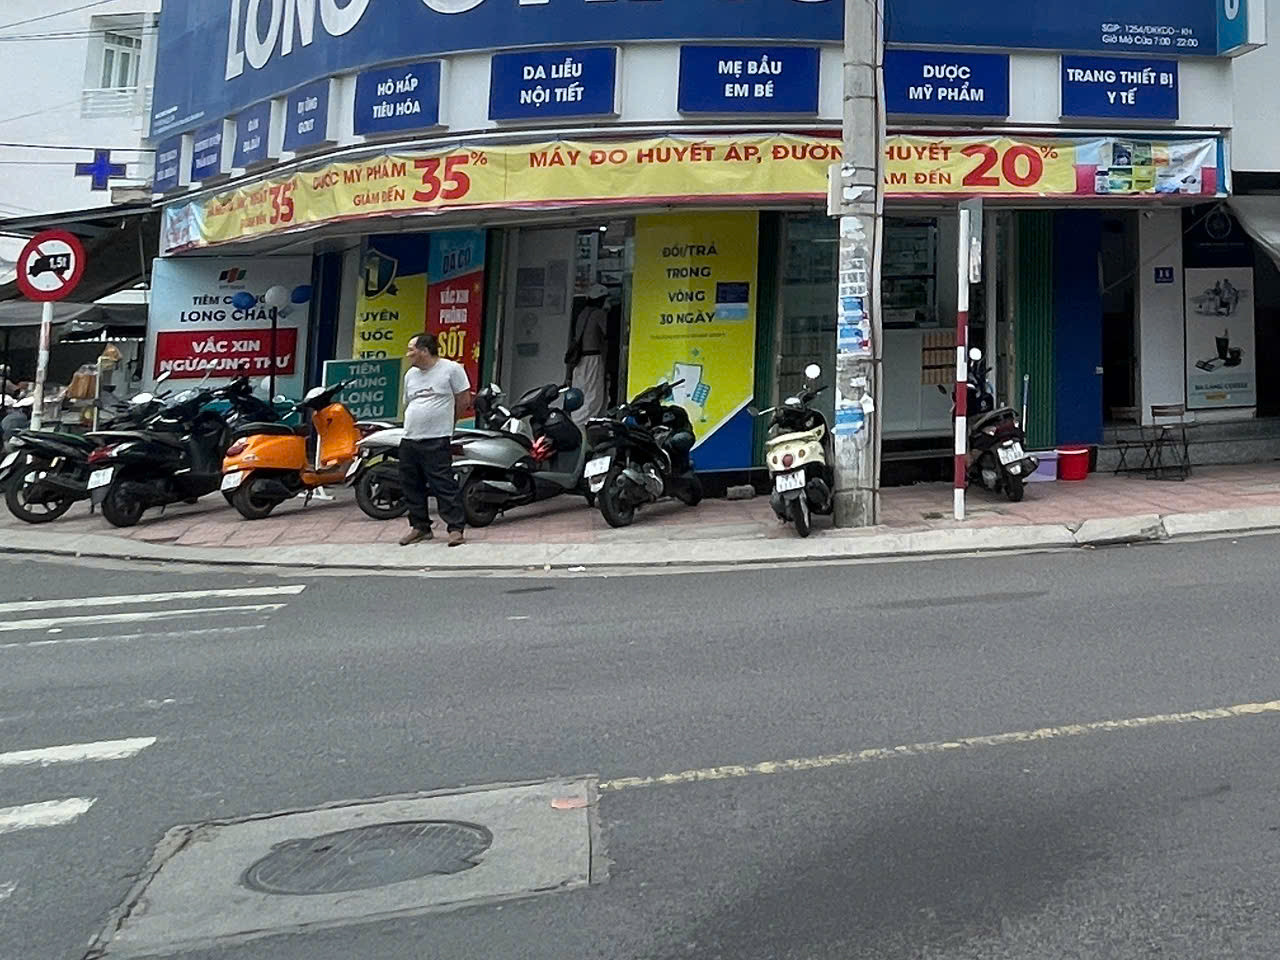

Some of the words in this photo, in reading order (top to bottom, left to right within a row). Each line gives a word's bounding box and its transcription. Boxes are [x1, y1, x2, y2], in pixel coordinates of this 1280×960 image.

[1102, 34, 1118, 44] Giờ
[1119, 36, 1133, 45] Mở
[1134, 36, 1153, 45] Cửa
[524, 65, 547, 81] DA
[551, 57, 583, 79] LIỄU
[718, 61, 743, 81] MẸ
[747, 54, 783, 77] BẦU
[923, 63, 971, 83] DƯỢC
[377, 81, 394, 97] HÔ
[395, 76, 419, 94] HẤP
[1067, 67, 1117, 84] TRANG
[1120, 67, 1157, 85] THIẾT
[1160, 72, 1174, 89] BỊ
[520, 86, 549, 107] NỘI
[554, 80, 585, 103] TIẾT
[725, 84, 748, 98] EM
[754, 80, 774, 98] BÉ
[909, 83, 934, 101] MỸ
[938, 79, 984, 102] PHẨM
[1107, 91, 1117, 105] Y
[1120, 87, 1138, 105] TẾ
[373, 99, 395, 118] TIÊU
[398, 99, 421, 116] HÓA
[529, 146, 580, 168] MÁY
[588, 148, 628, 165] ĐO
[636, 140, 716, 164] HUYẾT
[723, 143, 762, 163] ÁP,
[771, 143, 843, 161] ĐƯỜN
[343, 164, 362, 184] MỸ
[366, 159, 406, 181] PHẨM
[961, 143, 1059, 188] 20%
[413, 151, 488, 203] 35%
[914, 168, 951, 187] ĐẾN
[666, 267, 712, 279] TRONG
[668, 289, 705, 303] VÒNG
[181, 310, 226, 323] LONG
[360, 309, 399, 321] UYÊN
[660, 314, 674, 325] 30
[676, 309, 716, 324] NGÀY
[360, 327, 393, 341] UỐC
[438, 326, 468, 358] SỐT
[192, 336, 228, 353] VẮC
[231, 339, 261, 353] XIN
[349, 362, 380, 375] TIÊM
[340, 391, 385, 404] LONG
[350, 404, 385, 419] HÂU
